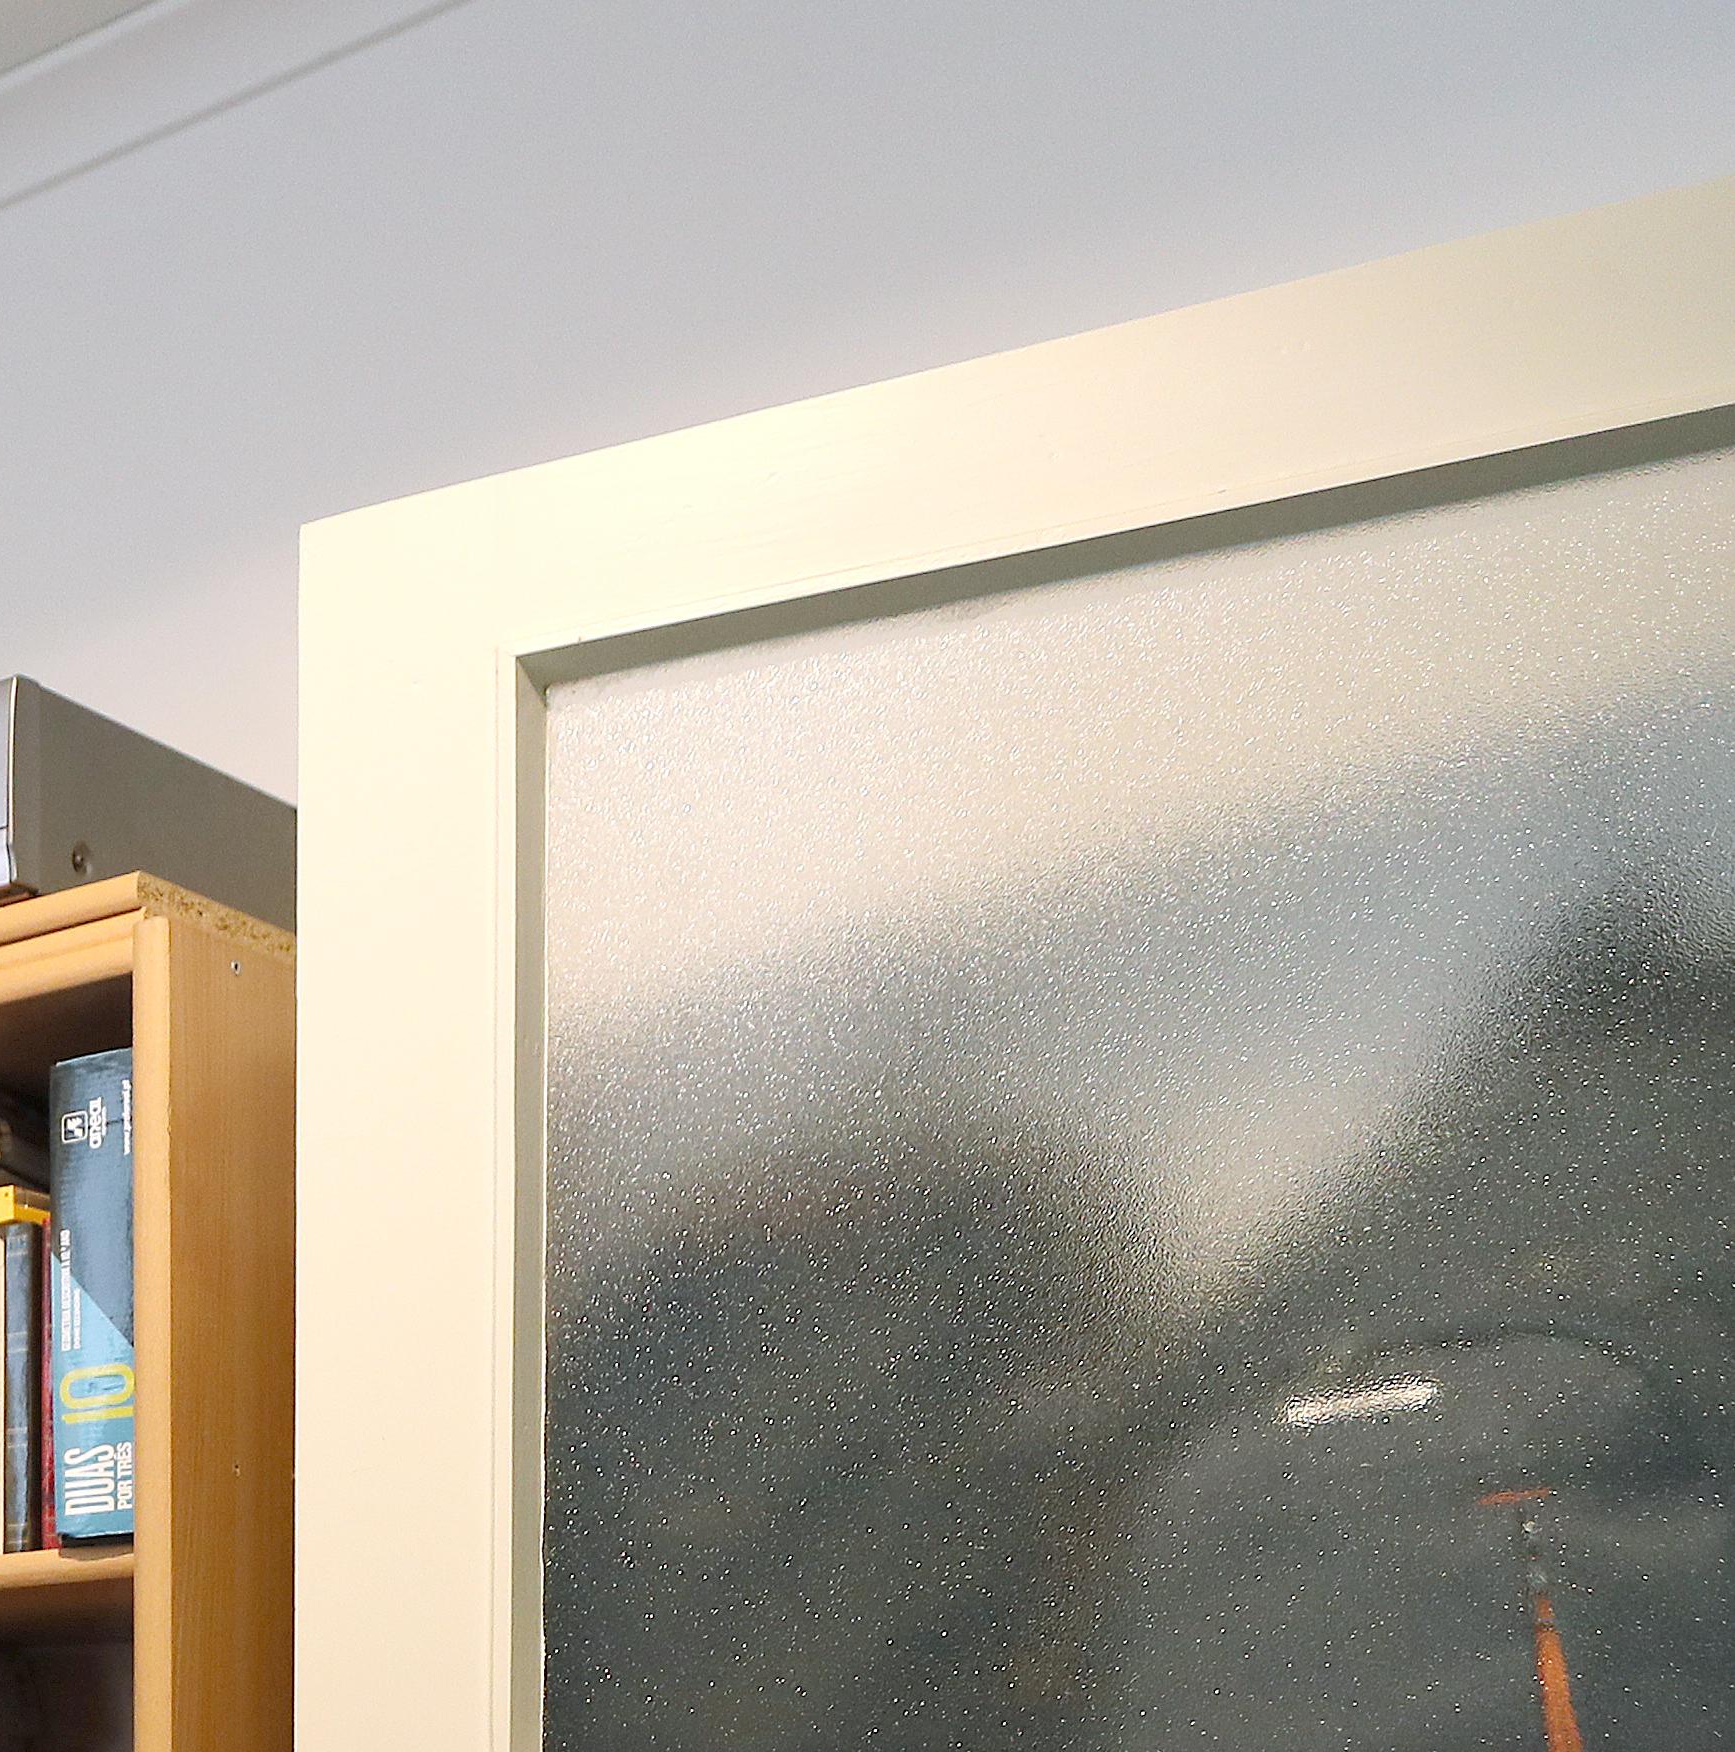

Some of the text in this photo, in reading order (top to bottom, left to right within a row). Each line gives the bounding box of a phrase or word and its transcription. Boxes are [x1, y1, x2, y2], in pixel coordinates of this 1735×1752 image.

[60, 1363, 135, 1424] 10
[64, 1443, 116, 1516] DUAS
[114, 1441, 133, 1511] POR TRÊS
